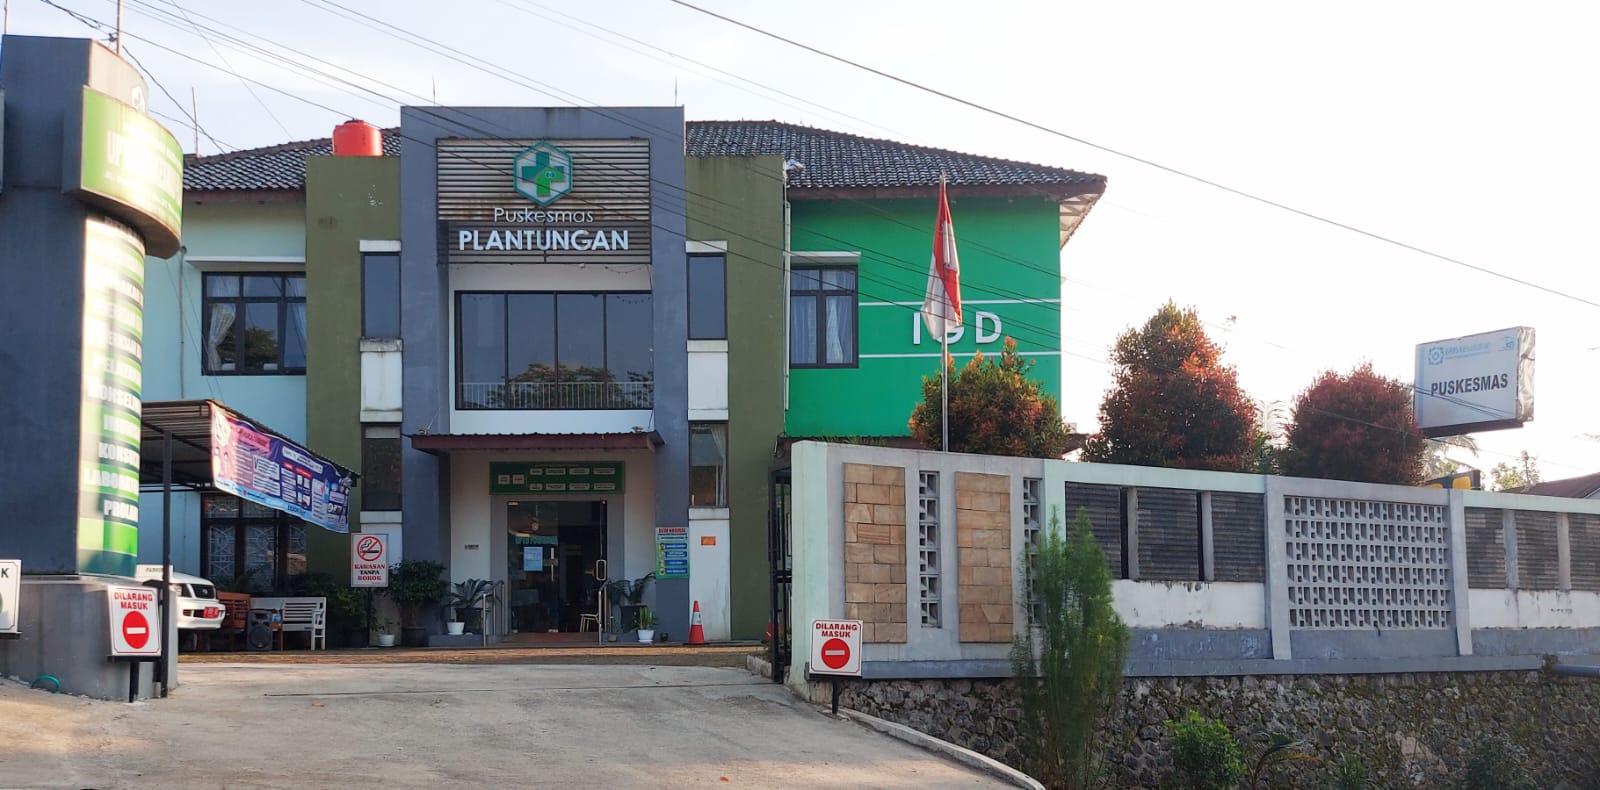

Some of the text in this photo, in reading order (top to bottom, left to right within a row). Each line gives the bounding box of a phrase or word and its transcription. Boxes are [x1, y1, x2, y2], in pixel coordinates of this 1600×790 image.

[493, 207, 594, 223] Puskesmas
[459, 229, 629, 251] PLANTUNGAN
[1431, 373, 1509, 397] PUSKESMAS
[114, 591, 153, 602] DILARANG
[121, 601, 149, 610] MASUK
[815, 622, 858, 631] DILARANG
[821, 630, 851, 638] MASUK
